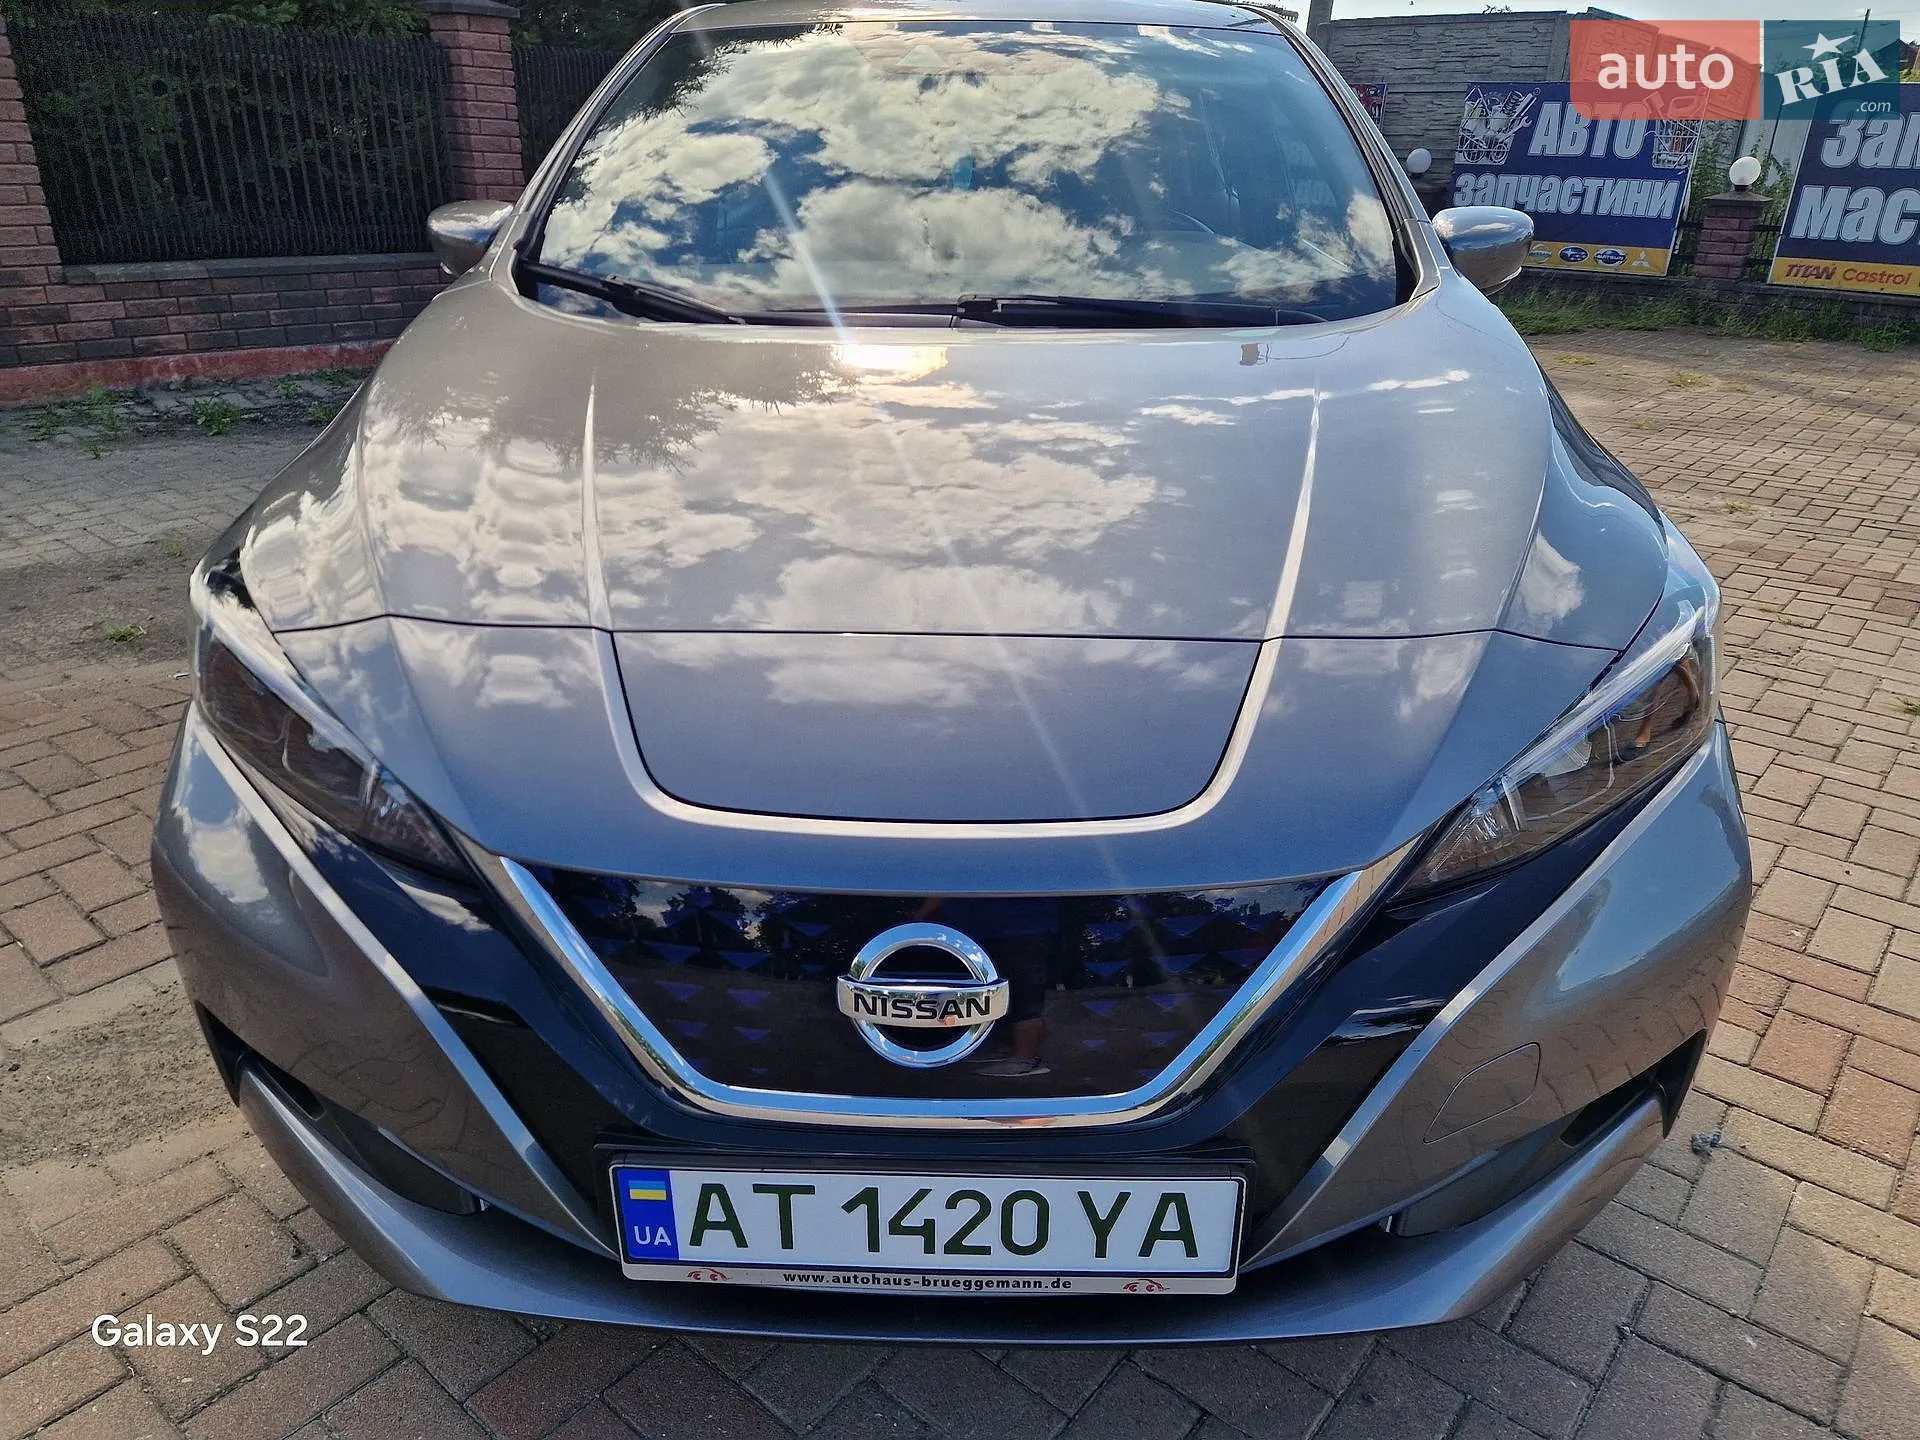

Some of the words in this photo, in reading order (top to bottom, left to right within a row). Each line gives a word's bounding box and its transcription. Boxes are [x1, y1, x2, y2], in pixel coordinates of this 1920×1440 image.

[1527, 101, 1651, 160] АВТО
[1453, 172, 1681, 220] запчастини
[1789, 184, 1920, 246] мас
[1842, 267, 1913, 286] Castrol
[852, 993, 991, 1020] NISSAN
[634, 1225, 672, 1247] UA
[689, 1183, 816, 1250] AT
[841, 1186, 1050, 1256] 1420
[1077, 1191, 1199, 1258] YA
[782, 1271, 1073, 1291] www.autohaus-brueggemann.de
